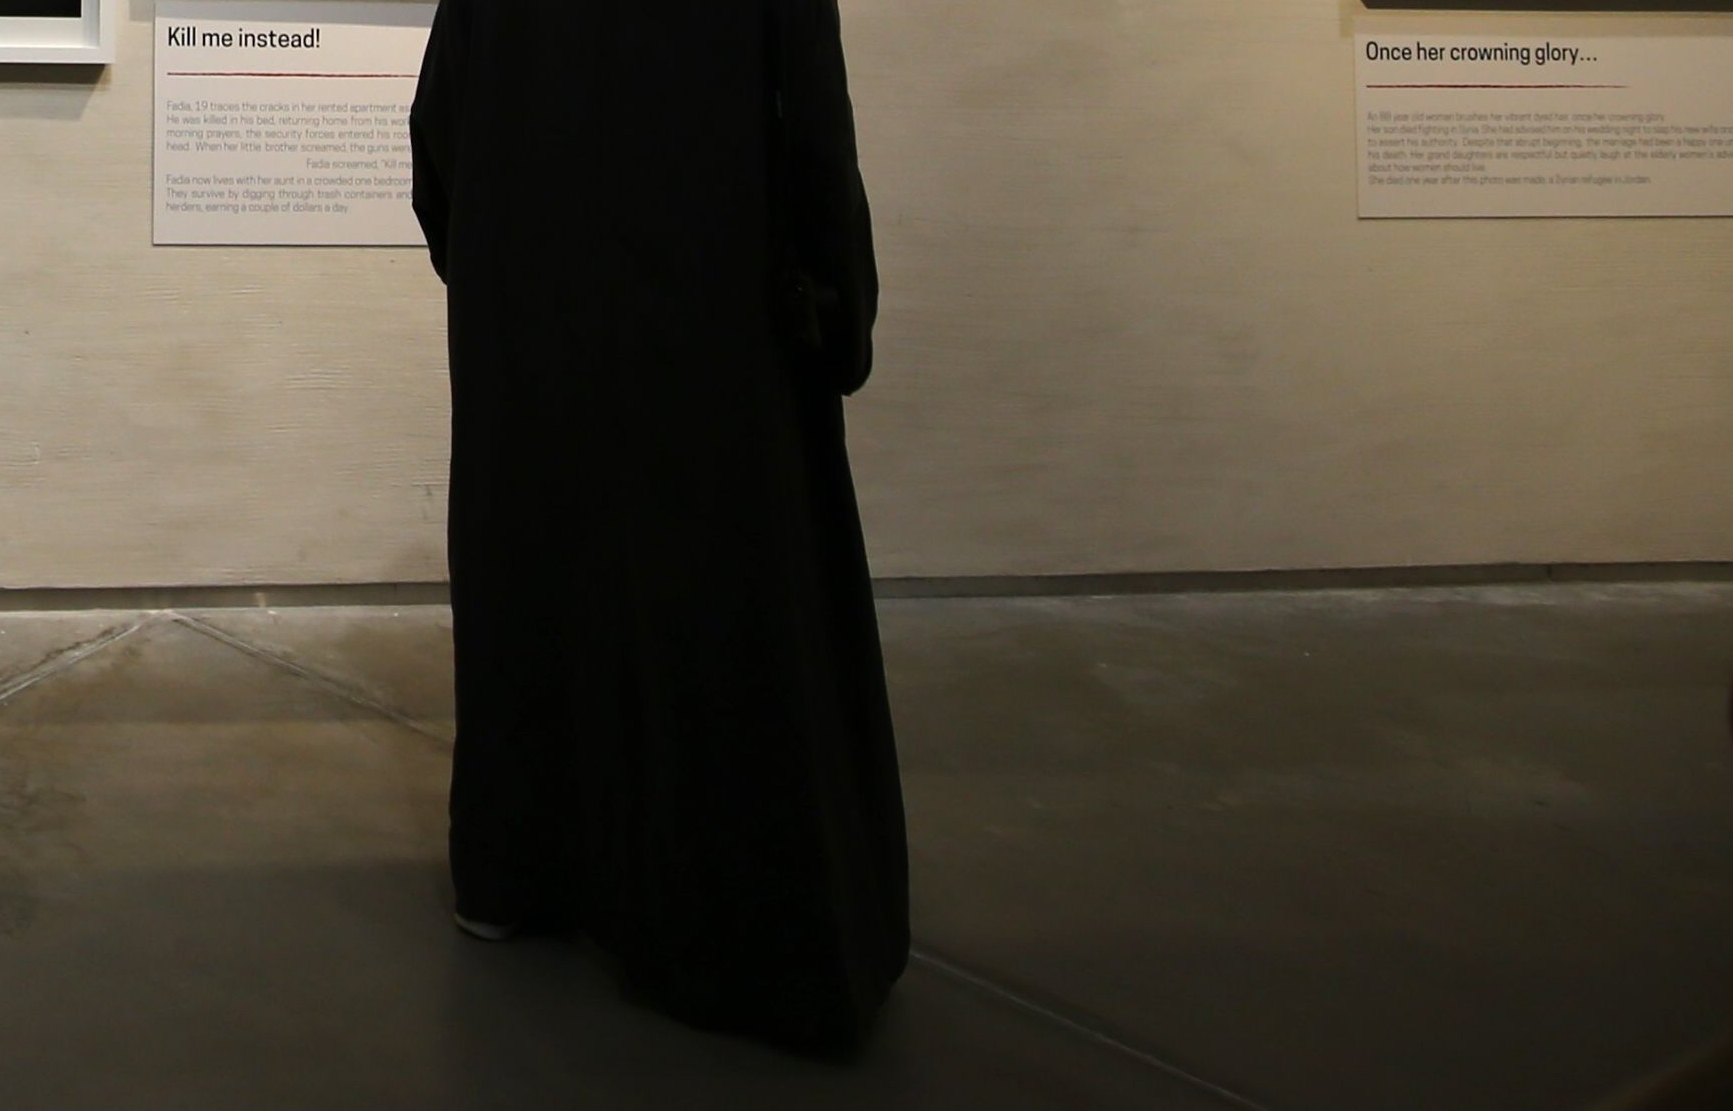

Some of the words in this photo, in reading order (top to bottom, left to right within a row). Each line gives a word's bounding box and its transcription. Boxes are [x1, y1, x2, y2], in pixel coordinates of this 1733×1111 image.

[168, 26, 196, 46] Kill
[202, 32, 233, 47] me
[239, 28, 320, 48] instead!
[1366, 41, 1412, 61] Once
[1417, 41, 1445, 61] her
[1450, 43, 1530, 66] crowning
[1535, 42, 1597, 66] glory...
[195, 101, 208, 111] 19
[210, 101, 239, 111] traces
[242, 101, 257, 111] the
[259, 101, 290, 111] cracks
[302, 101, 315, 111] her
[318, 102, 347, 112] rented
[350, 102, 396, 114] apartment
[166, 113, 179, 123] He
[182, 116, 201, 124] was
[203, 114, 227, 124] killed
[240, 114, 253, 124] his
[279, 114, 320, 127] returning
[322, 115, 347, 125] home
[350, 115, 372, 125] from
[375, 115, 387, 125] his
[166, 127, 203, 139] morning
[246, 127, 261, 137] the
[265, 128, 302, 140] security
[305, 128, 335, 138] forces
[338, 128, 373, 138] entered
[377, 129, 390, 138] his
[195, 140, 222, 150] When
[224, 140, 238, 150] her
[241, 141, 261, 151] little
[265, 141, 298, 151] brother
[350, 142, 365, 152] the
[367, 144, 389, 154] guns
[306, 158, 330, 168] Fadia
[166, 174, 190, 184] Fadia
[213, 174, 235, 184] lives
[236, 174, 256, 184] with
[257, 174, 271, 184] her
[274, 175, 295, 184] aunt
[314, 175, 353, 185] crowded
[166, 188, 187, 200] They
[192, 188, 225, 198] survive
[228, 188, 239, 200] by
[242, 188, 275, 200] digging
[279, 188, 314, 201] through
[317, 188, 341, 198] trash
[345, 188, 392, 198] containers
[205, 201, 239, 213] earning
[248, 201, 279, 214] couple
[281, 201, 290, 211] of
[292, 202, 322, 211] dollars
